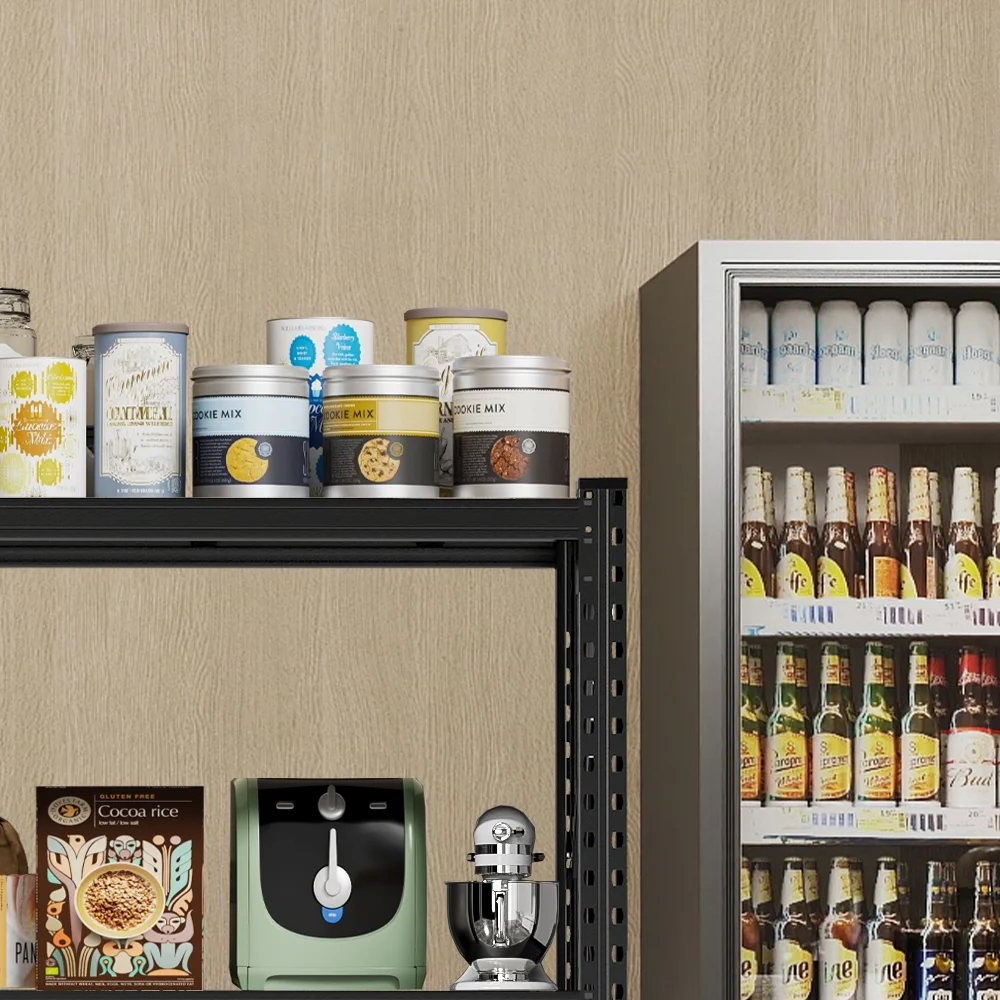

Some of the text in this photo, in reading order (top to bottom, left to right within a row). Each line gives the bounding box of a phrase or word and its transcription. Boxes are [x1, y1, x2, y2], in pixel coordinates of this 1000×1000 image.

[484, 404, 505, 413] MIX
[221, 410, 242, 418] MIX
[353, 410, 374, 418] MIX
[98, 804, 178, 818] Cocoa rice
[53, 813, 86, 823] ORGANIC
[16, 942, 36, 964] PAN
